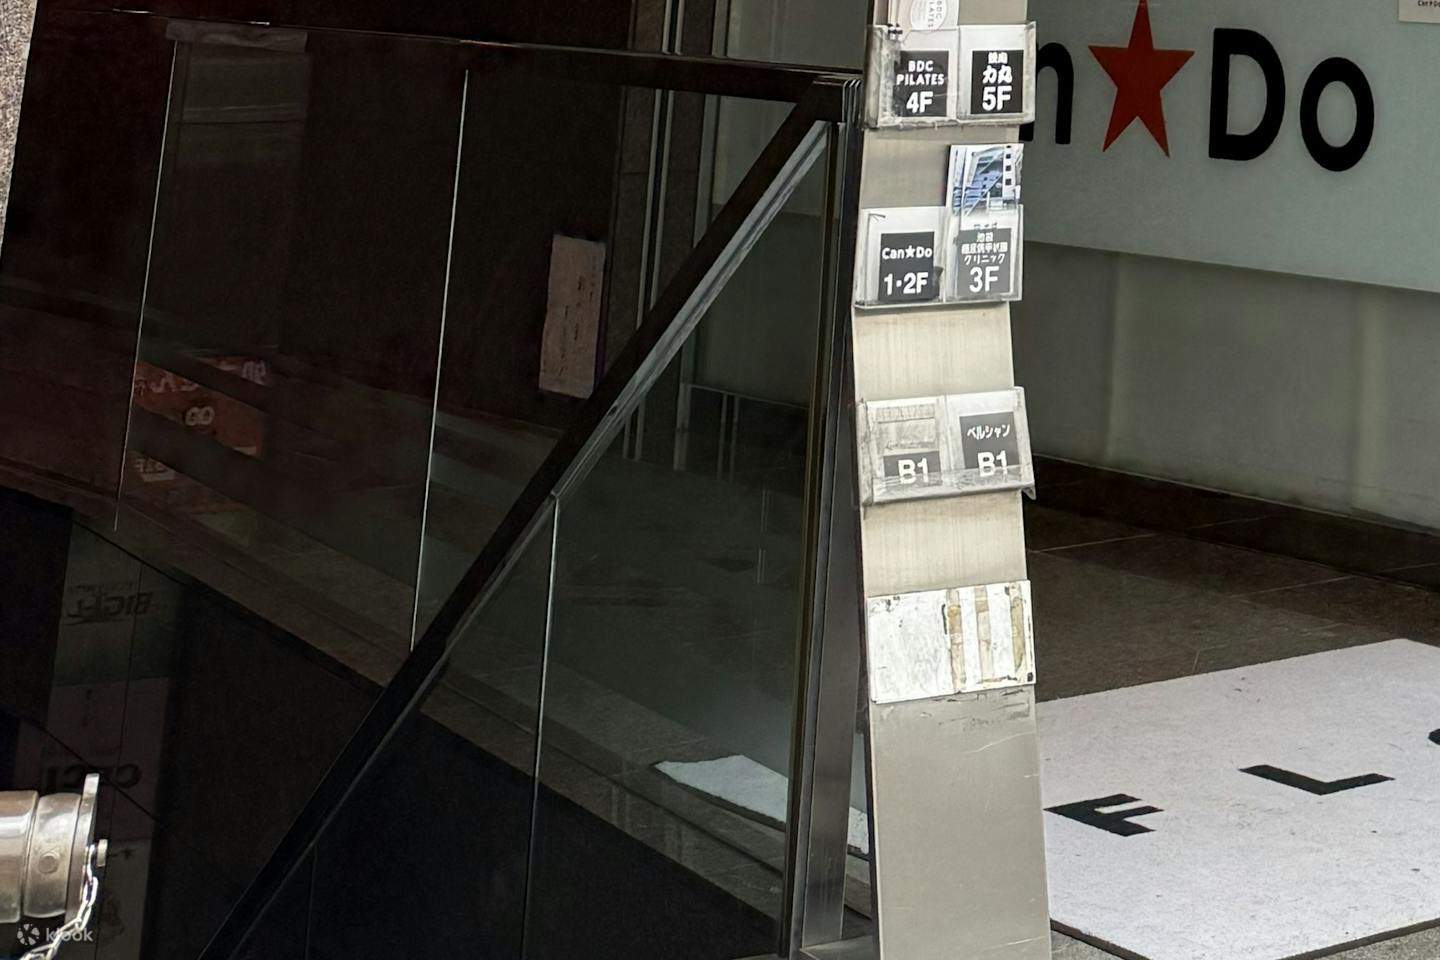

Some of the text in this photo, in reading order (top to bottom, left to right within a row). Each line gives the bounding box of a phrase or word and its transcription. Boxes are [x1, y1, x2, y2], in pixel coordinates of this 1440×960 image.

[908, 60, 934, 73] BDC
[896, 74, 945, 86] PILATES
[906, 91, 934, 113] 4F
[982, 86, 1012, 111] 5F
[964, 254, 1006, 265] クリニック
[969, 266, 1000, 293] 3F
[898, 458, 930, 484] B1
[978, 450, 1008, 477] B1
